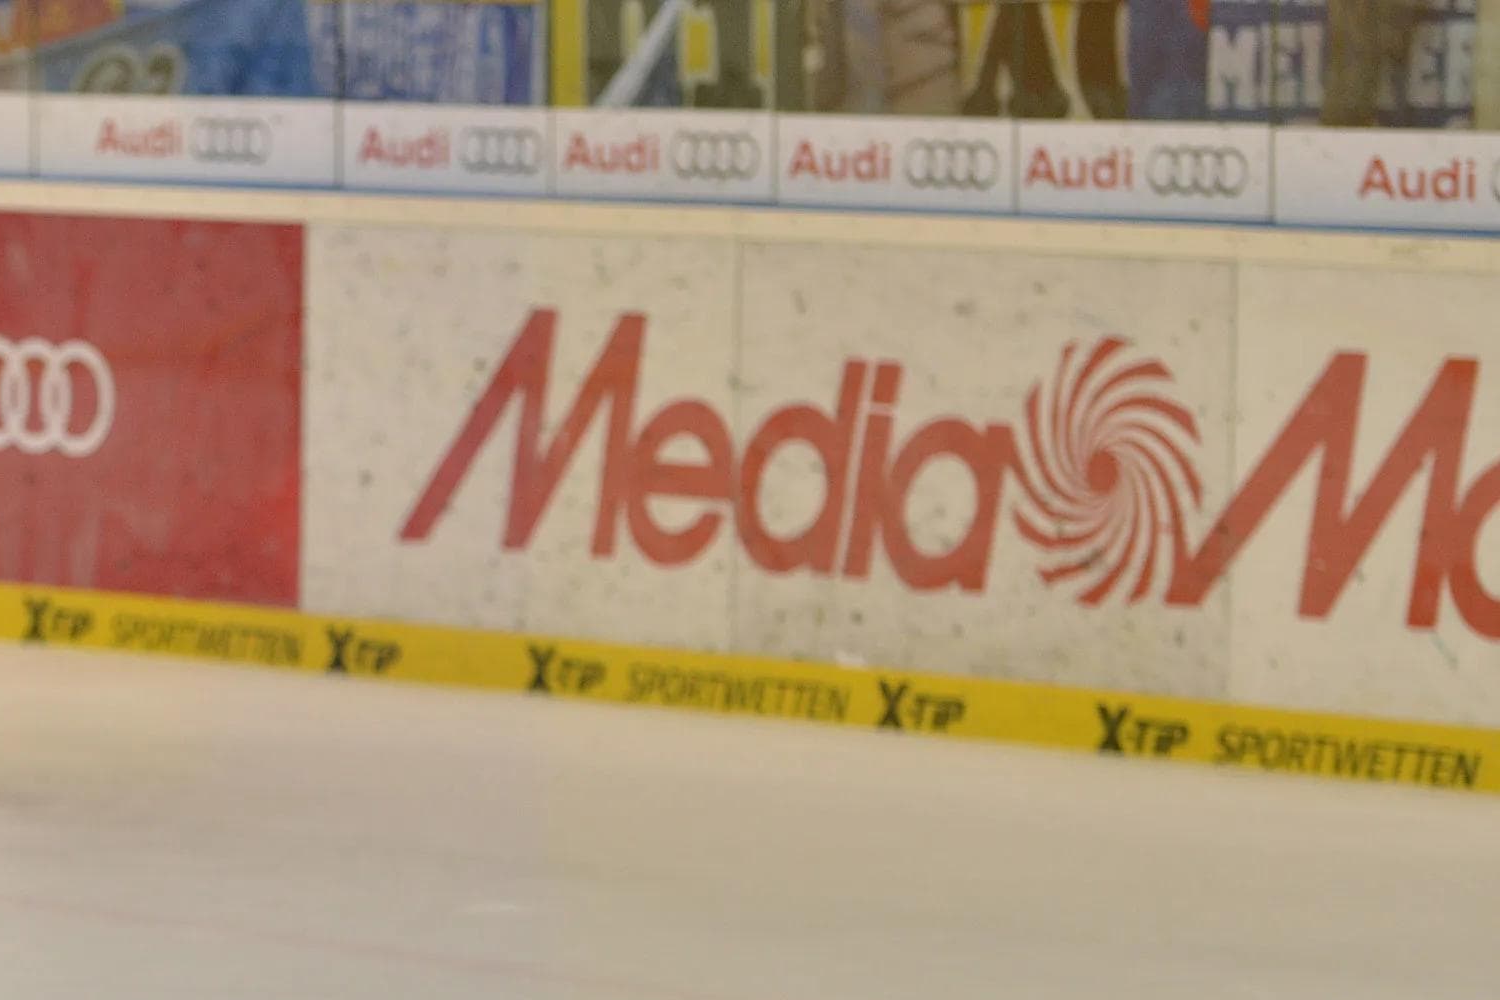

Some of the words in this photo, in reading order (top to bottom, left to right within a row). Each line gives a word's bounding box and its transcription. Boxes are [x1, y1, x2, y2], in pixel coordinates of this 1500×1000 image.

[97, 119, 183, 159] Audi
[360, 128, 451, 169] Audi
[564, 133, 661, 174] Audi
[789, 140, 892, 181] Audi
[1025, 146, 1134, 190] Audi
[1356, 155, 1477, 200] Audi
[397, 306, 1015, 595] Media
[625, 661, 849, 723] SPORTWETTEN
[1212, 723, 1482, 790] SPORTWETTEN
